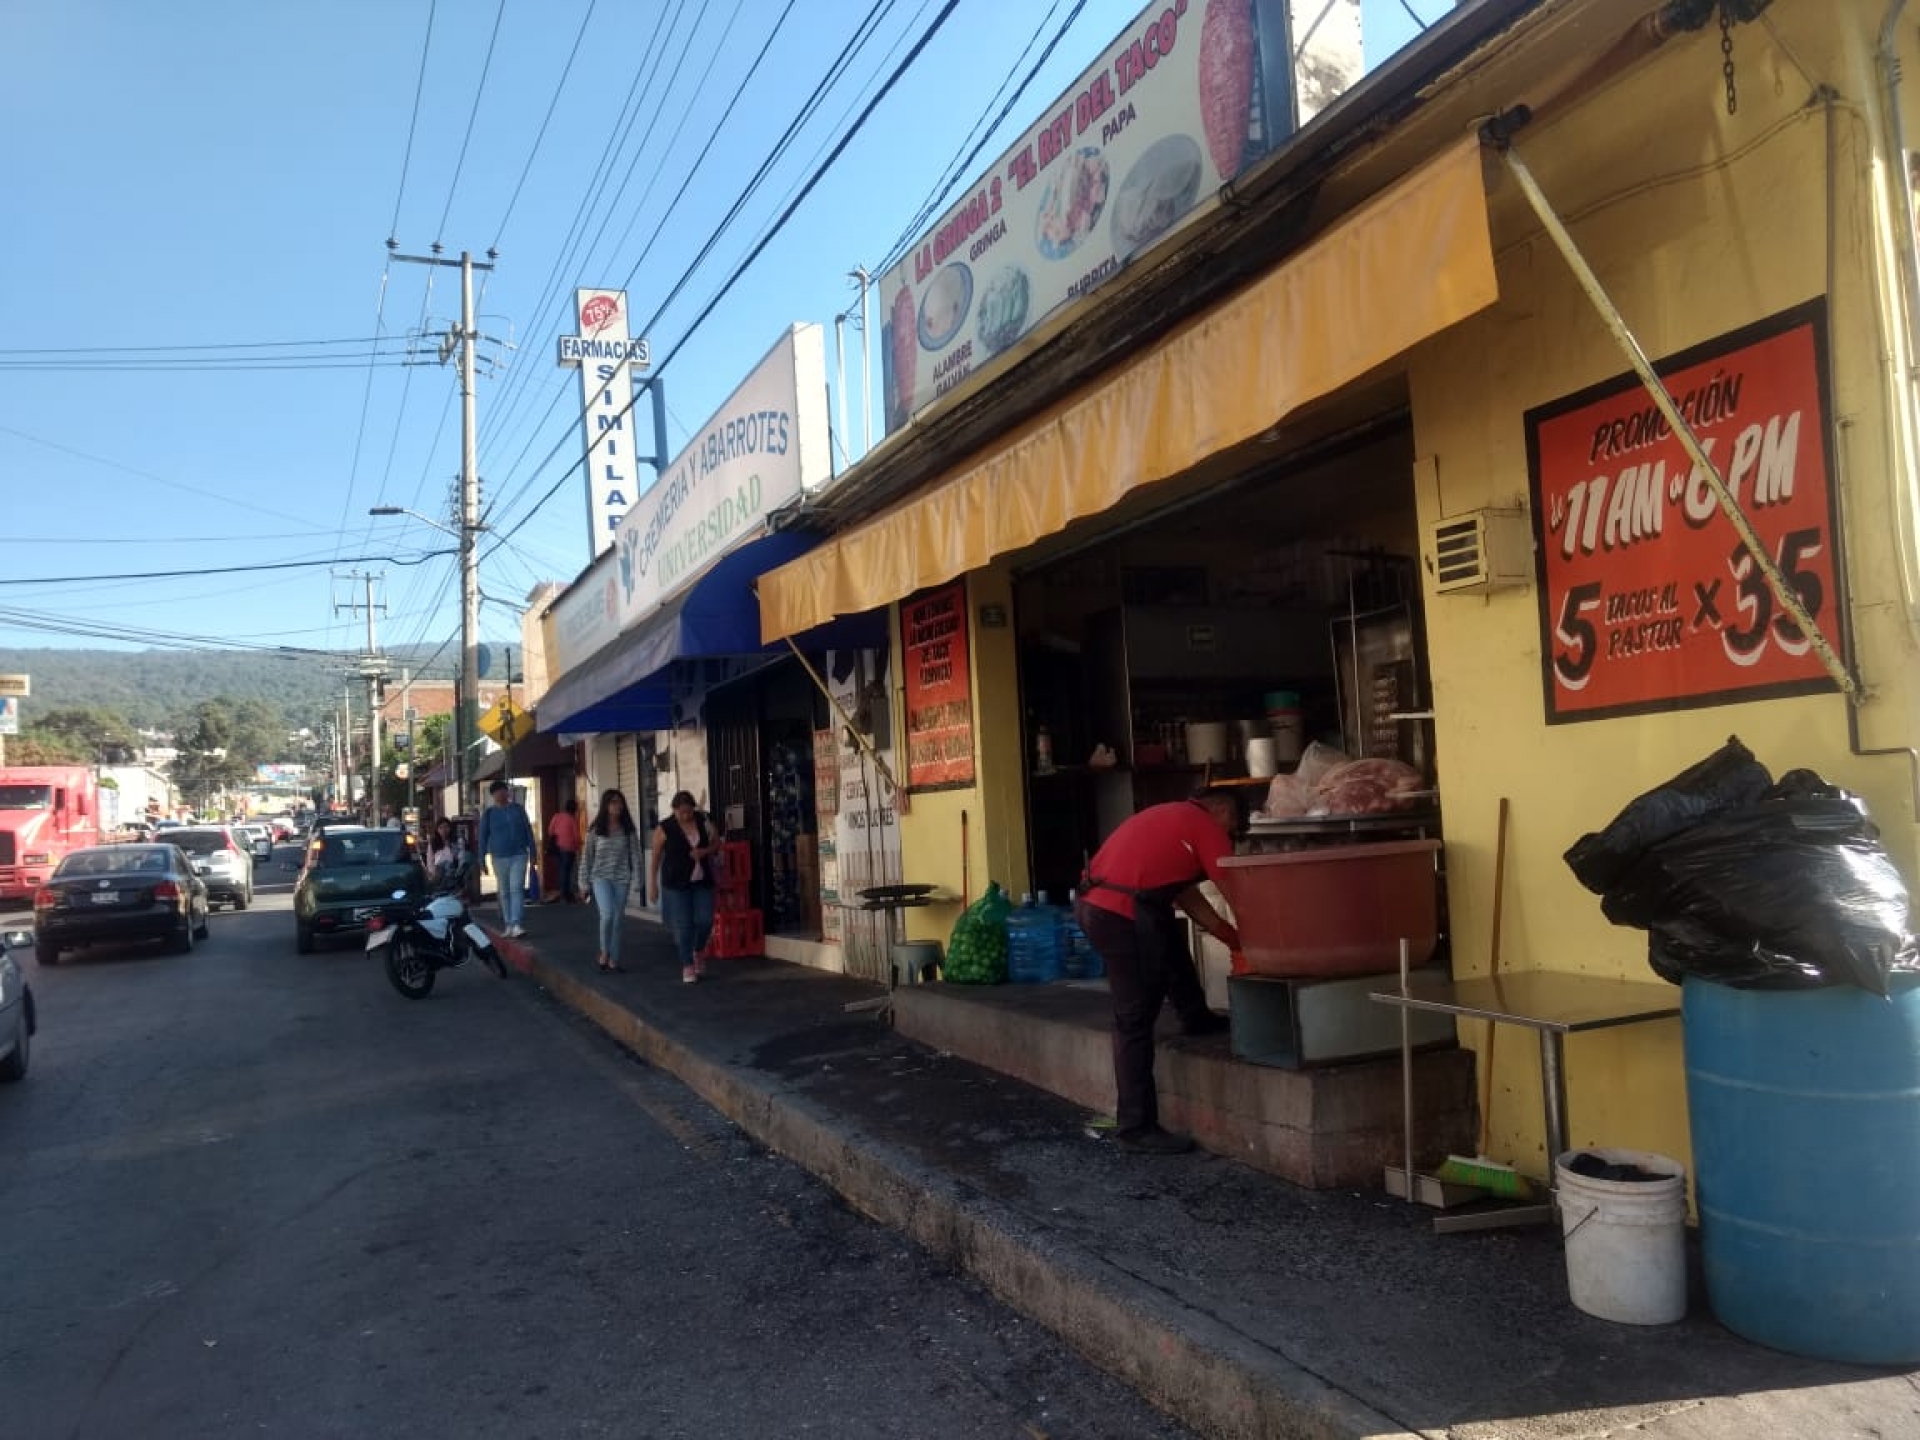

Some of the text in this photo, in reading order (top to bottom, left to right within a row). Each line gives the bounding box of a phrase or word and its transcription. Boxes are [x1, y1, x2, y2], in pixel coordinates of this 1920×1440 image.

[1103, 102, 1136, 147] PAPA
[915, 243, 933, 284] LA
[933, 189, 988, 265] GRINGA
[990, 176, 1003, 215] 2
[1038, 102, 1073, 171] REY
[1076, 68, 1115, 136] DEL
[970, 218, 1007, 262] GRINGA
[563, 339, 647, 361] FARMACIAS
[689, 451, 697, 488] Y
[700, 411, 788, 481] ABARROTES
[658, 474, 762, 588] UNIVERSIDAD
[1606, 581, 1681, 623] TACOS AL
[1556, 582, 1602, 688] 5
[1609, 617, 1684, 658] PASTOR
